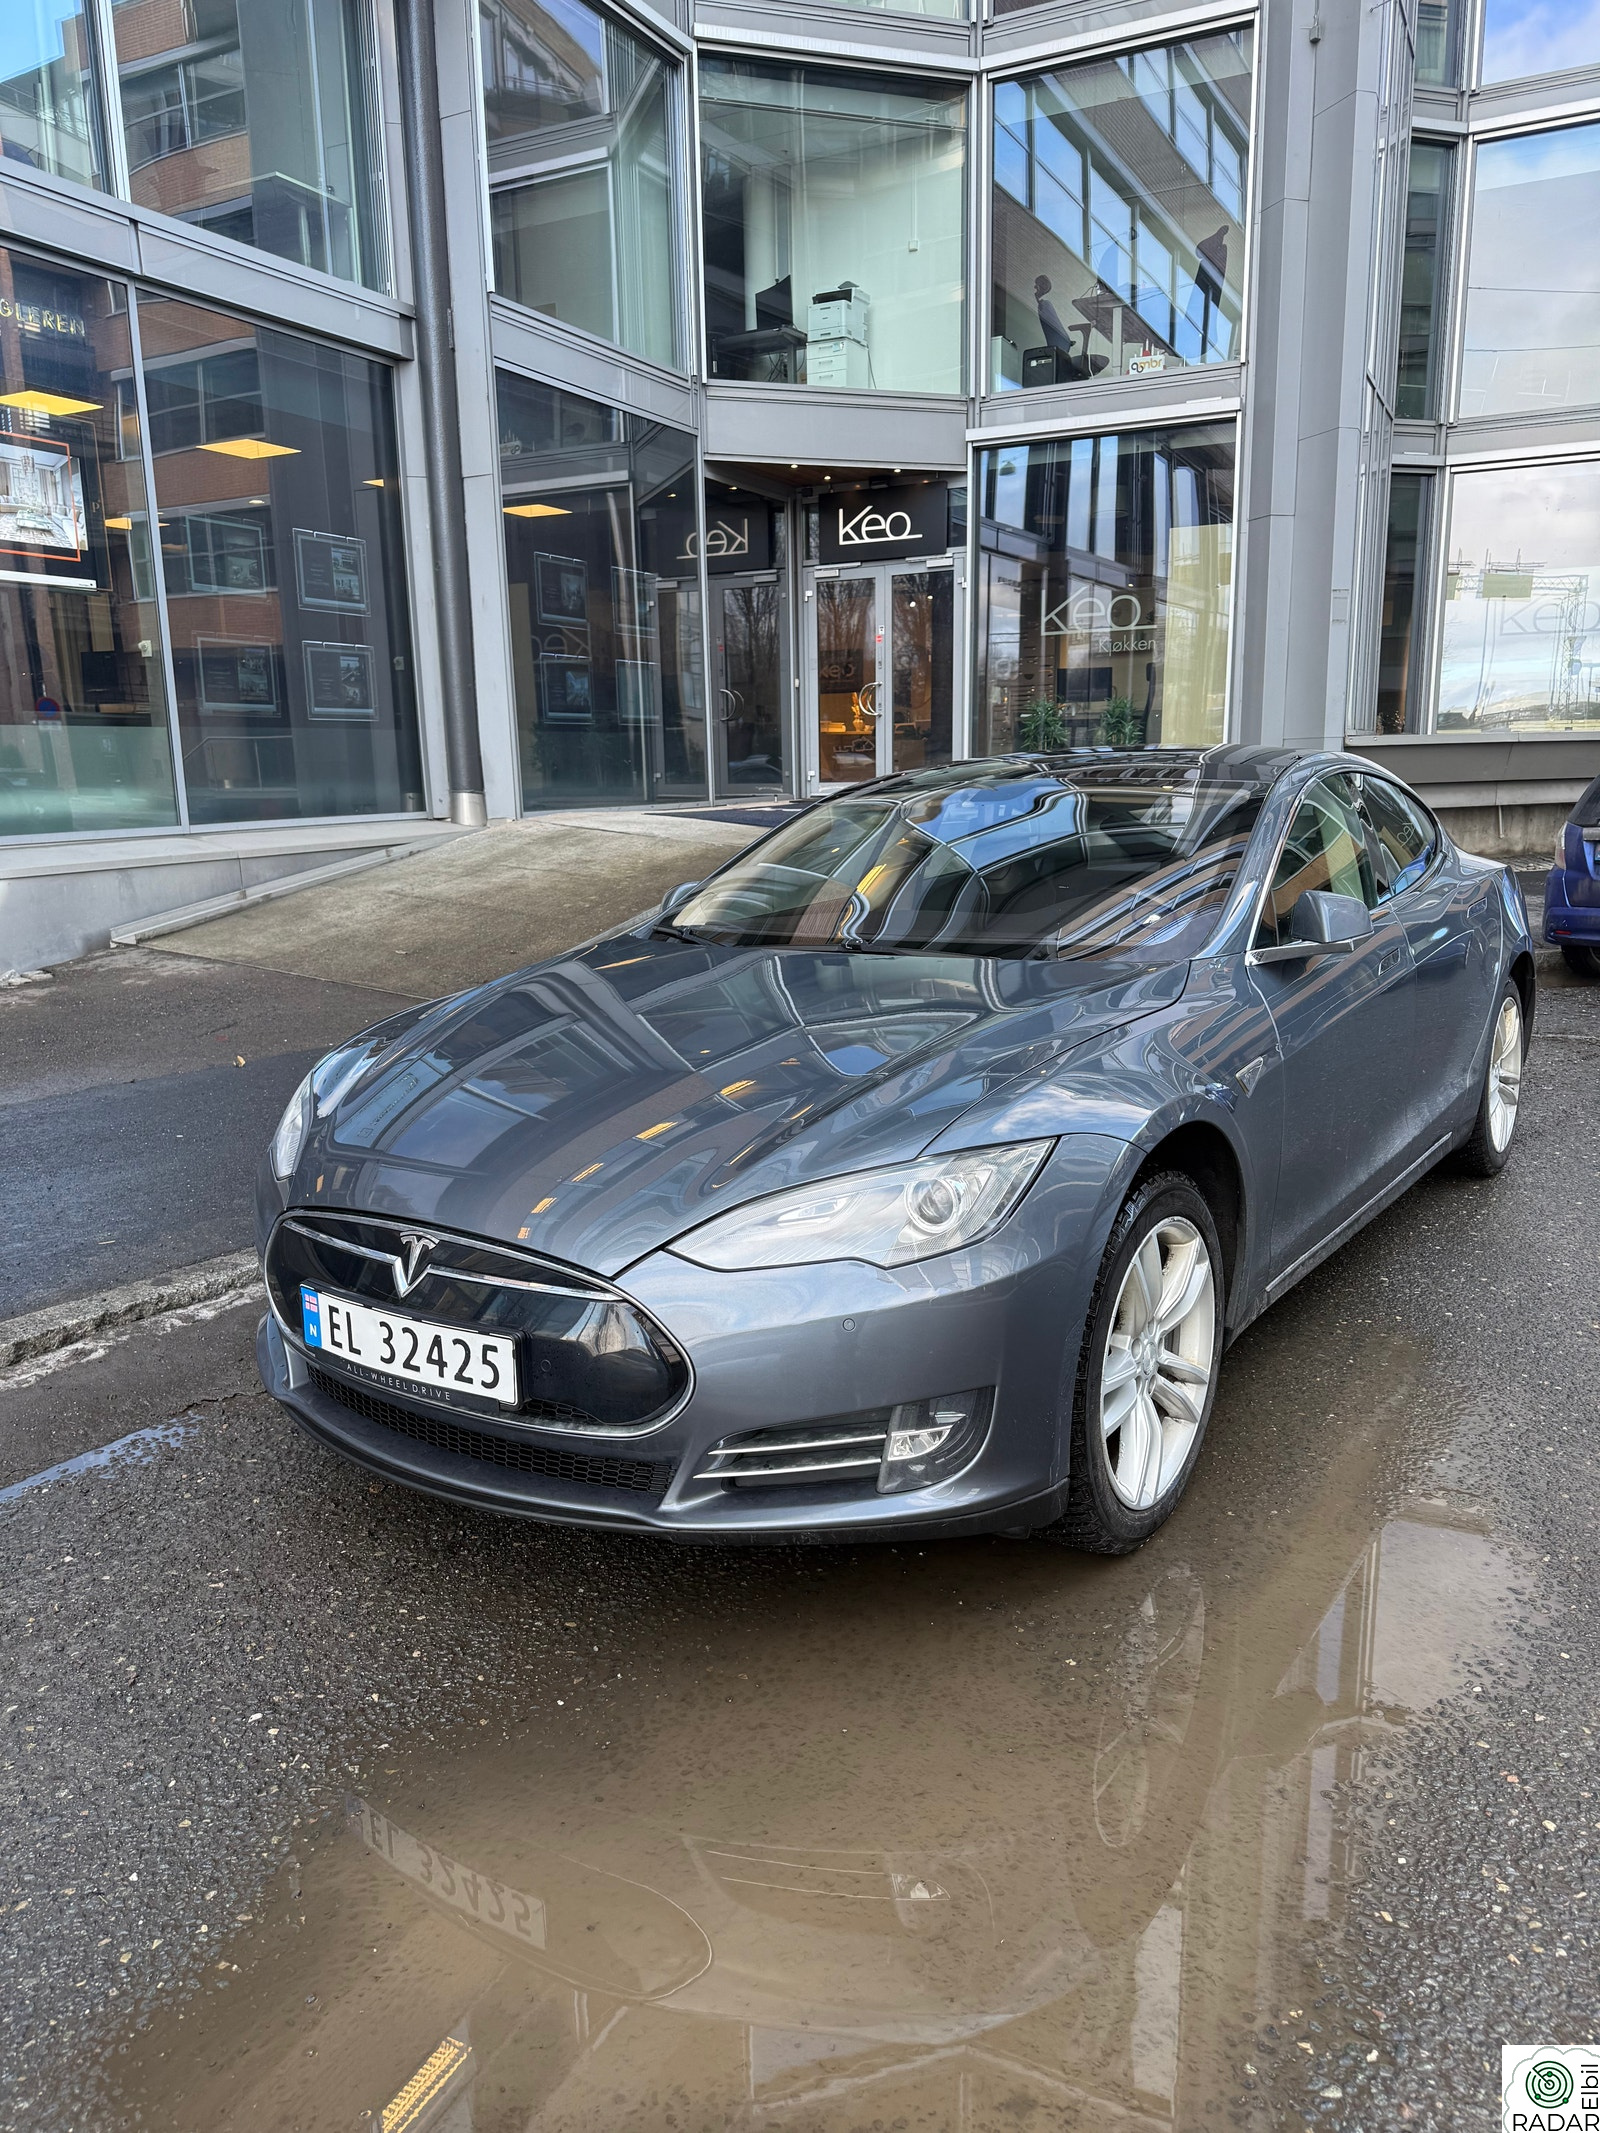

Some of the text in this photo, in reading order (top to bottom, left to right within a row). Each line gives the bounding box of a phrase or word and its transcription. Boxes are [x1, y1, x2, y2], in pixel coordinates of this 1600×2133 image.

[838, 505, 923, 546] Keo
[1041, 586, 1157, 636] Keo
[1098, 634, 1156, 657] Kjøkken
[310, 1323, 317, 1337] N
[328, 1304, 500, 1390] EL 32425
[412, 1384, 451, 1401] DRIVE
